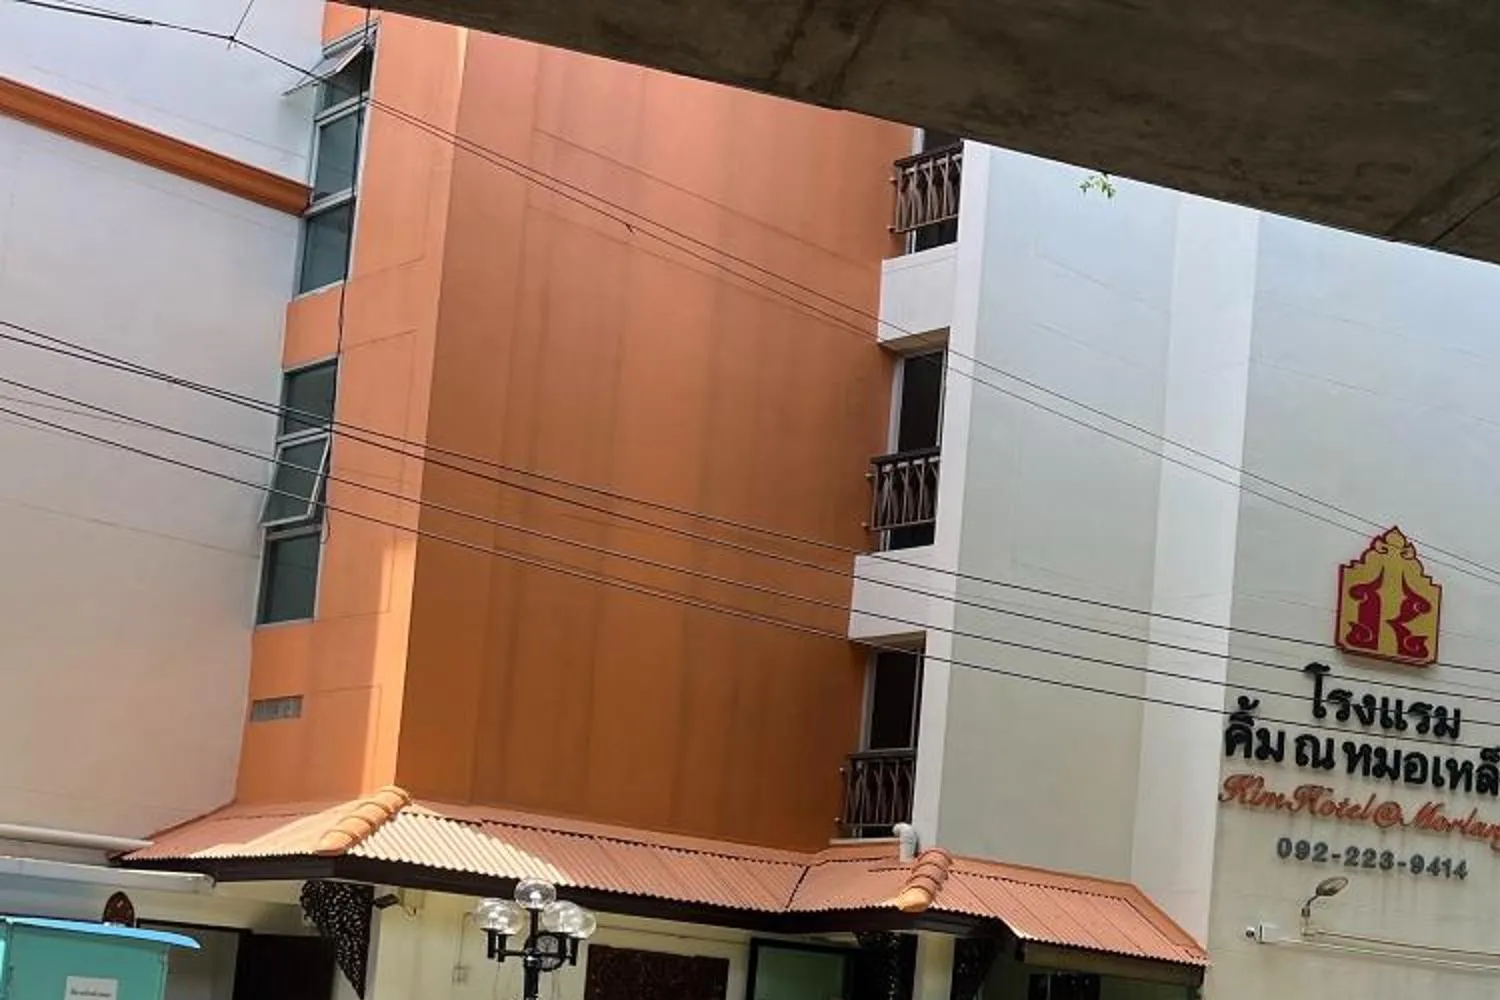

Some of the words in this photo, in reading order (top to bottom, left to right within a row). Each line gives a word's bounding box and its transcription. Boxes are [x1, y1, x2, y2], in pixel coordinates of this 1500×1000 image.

[1304, 662, 1461, 739] โรงแรม
[1218, 773, 1286, 810] Kim
[1276, 837, 1470, 880] 092-223-9414
